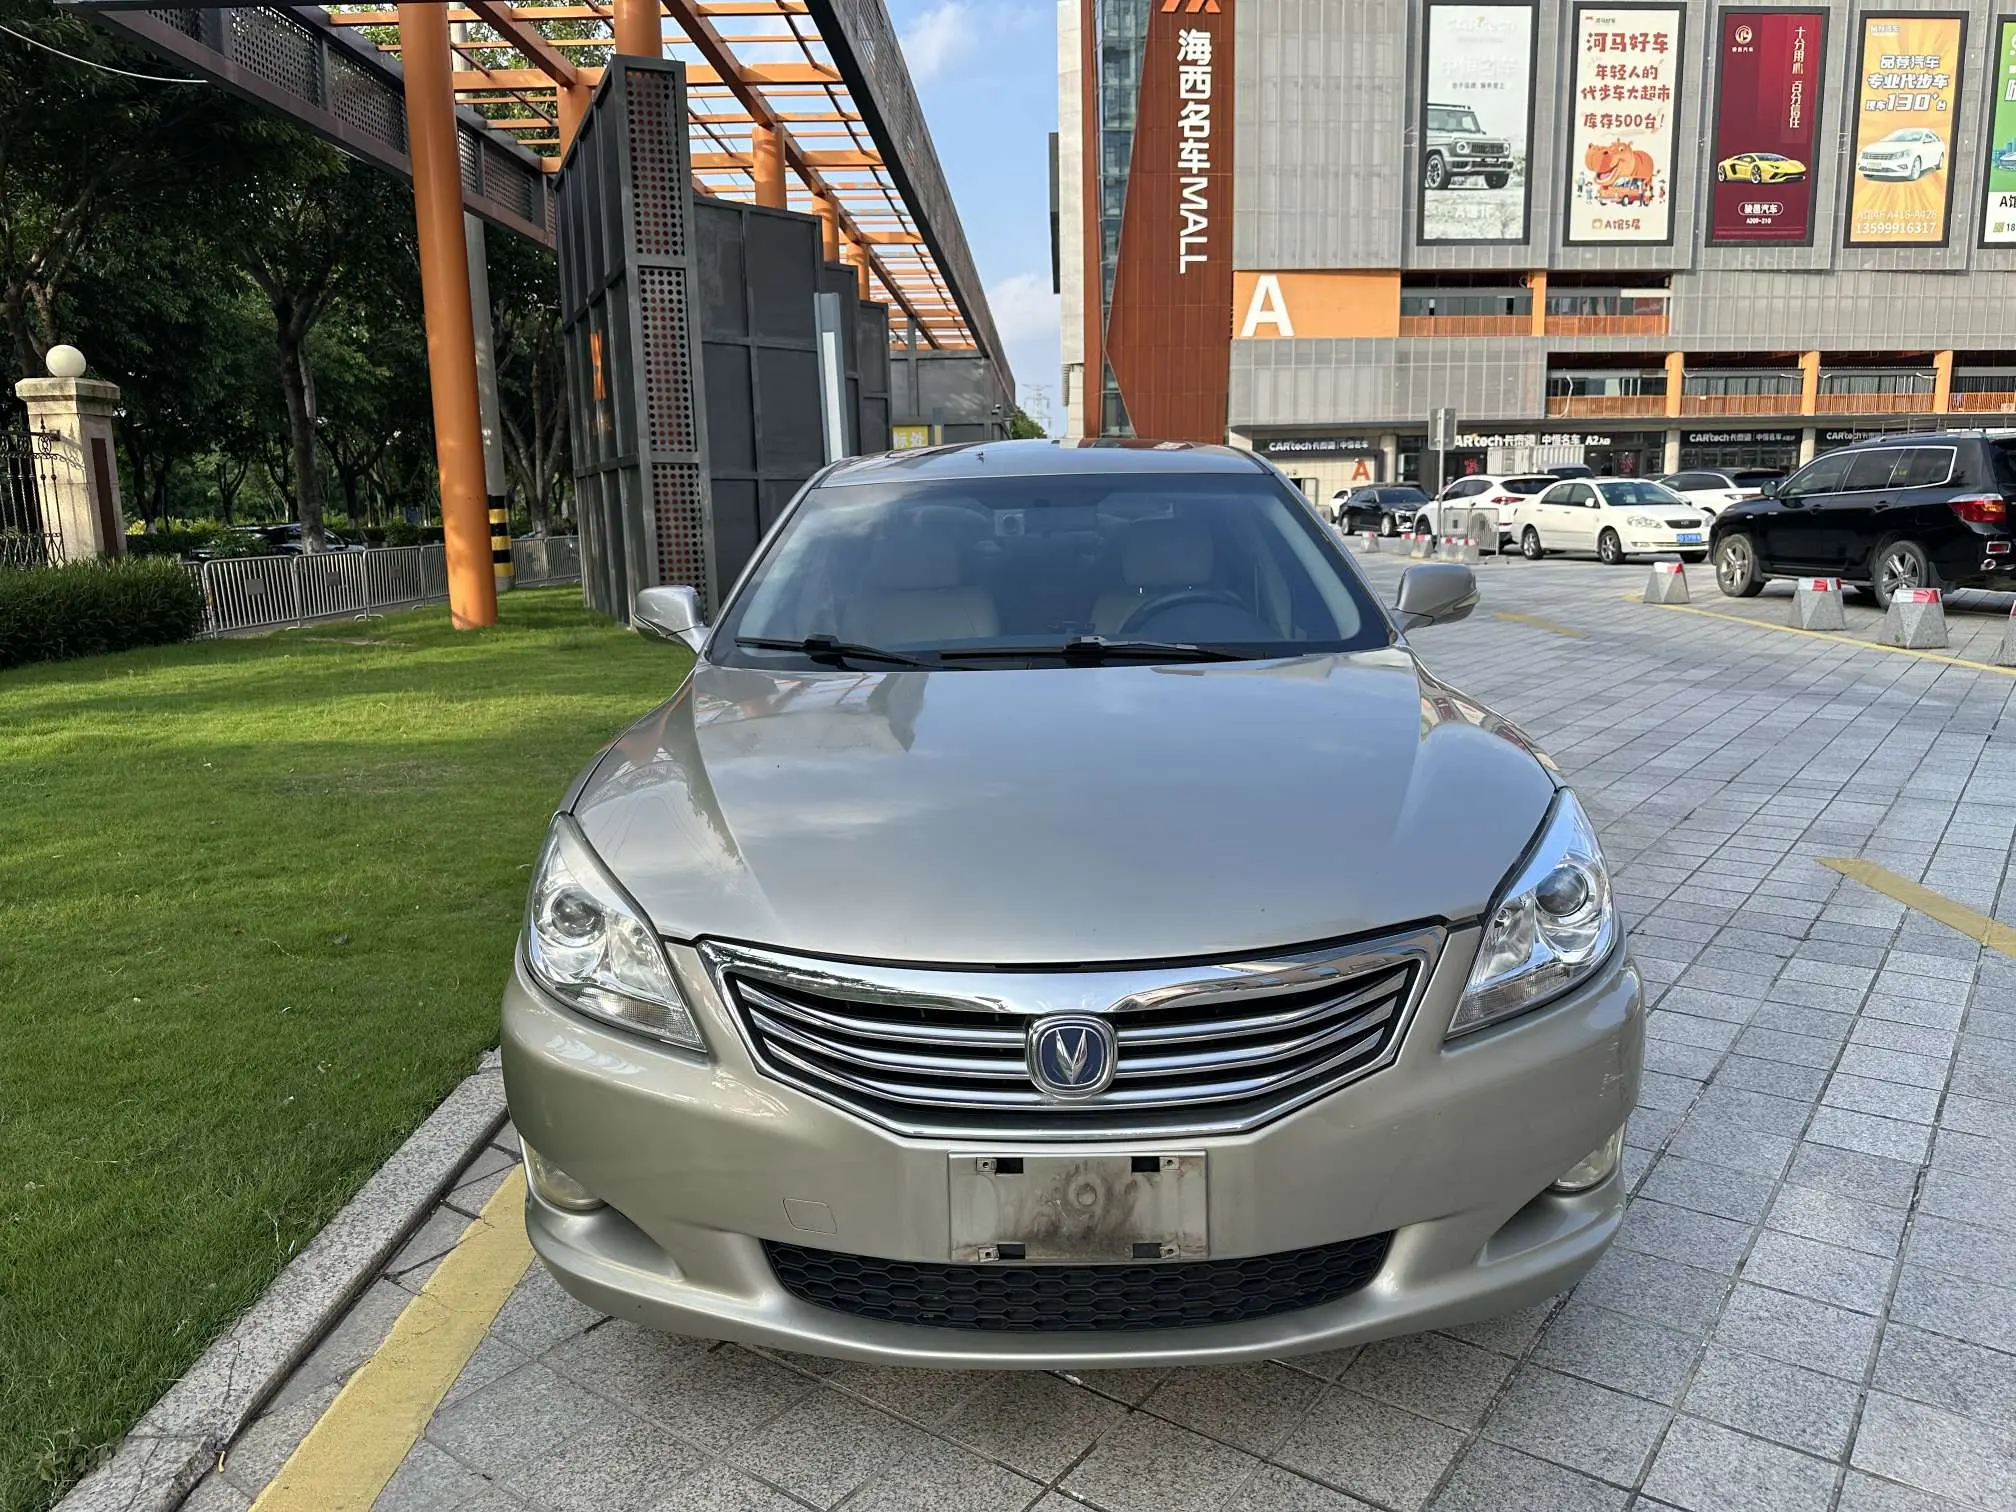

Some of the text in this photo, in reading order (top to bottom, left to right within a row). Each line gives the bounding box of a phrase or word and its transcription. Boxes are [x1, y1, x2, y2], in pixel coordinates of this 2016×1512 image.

[1586, 32, 1668, 53] 河马好车
[1595, 64, 1658, 80] 年轻人的
[1868, 73, 1949, 89] 专业代步车
[1581, 84, 1670, 101] 代步车大超市
[1177, 28, 1212, 274] 海西名车MALL
[1240, 274, 1295, 337] A
[1352, 459, 1371, 480] A
